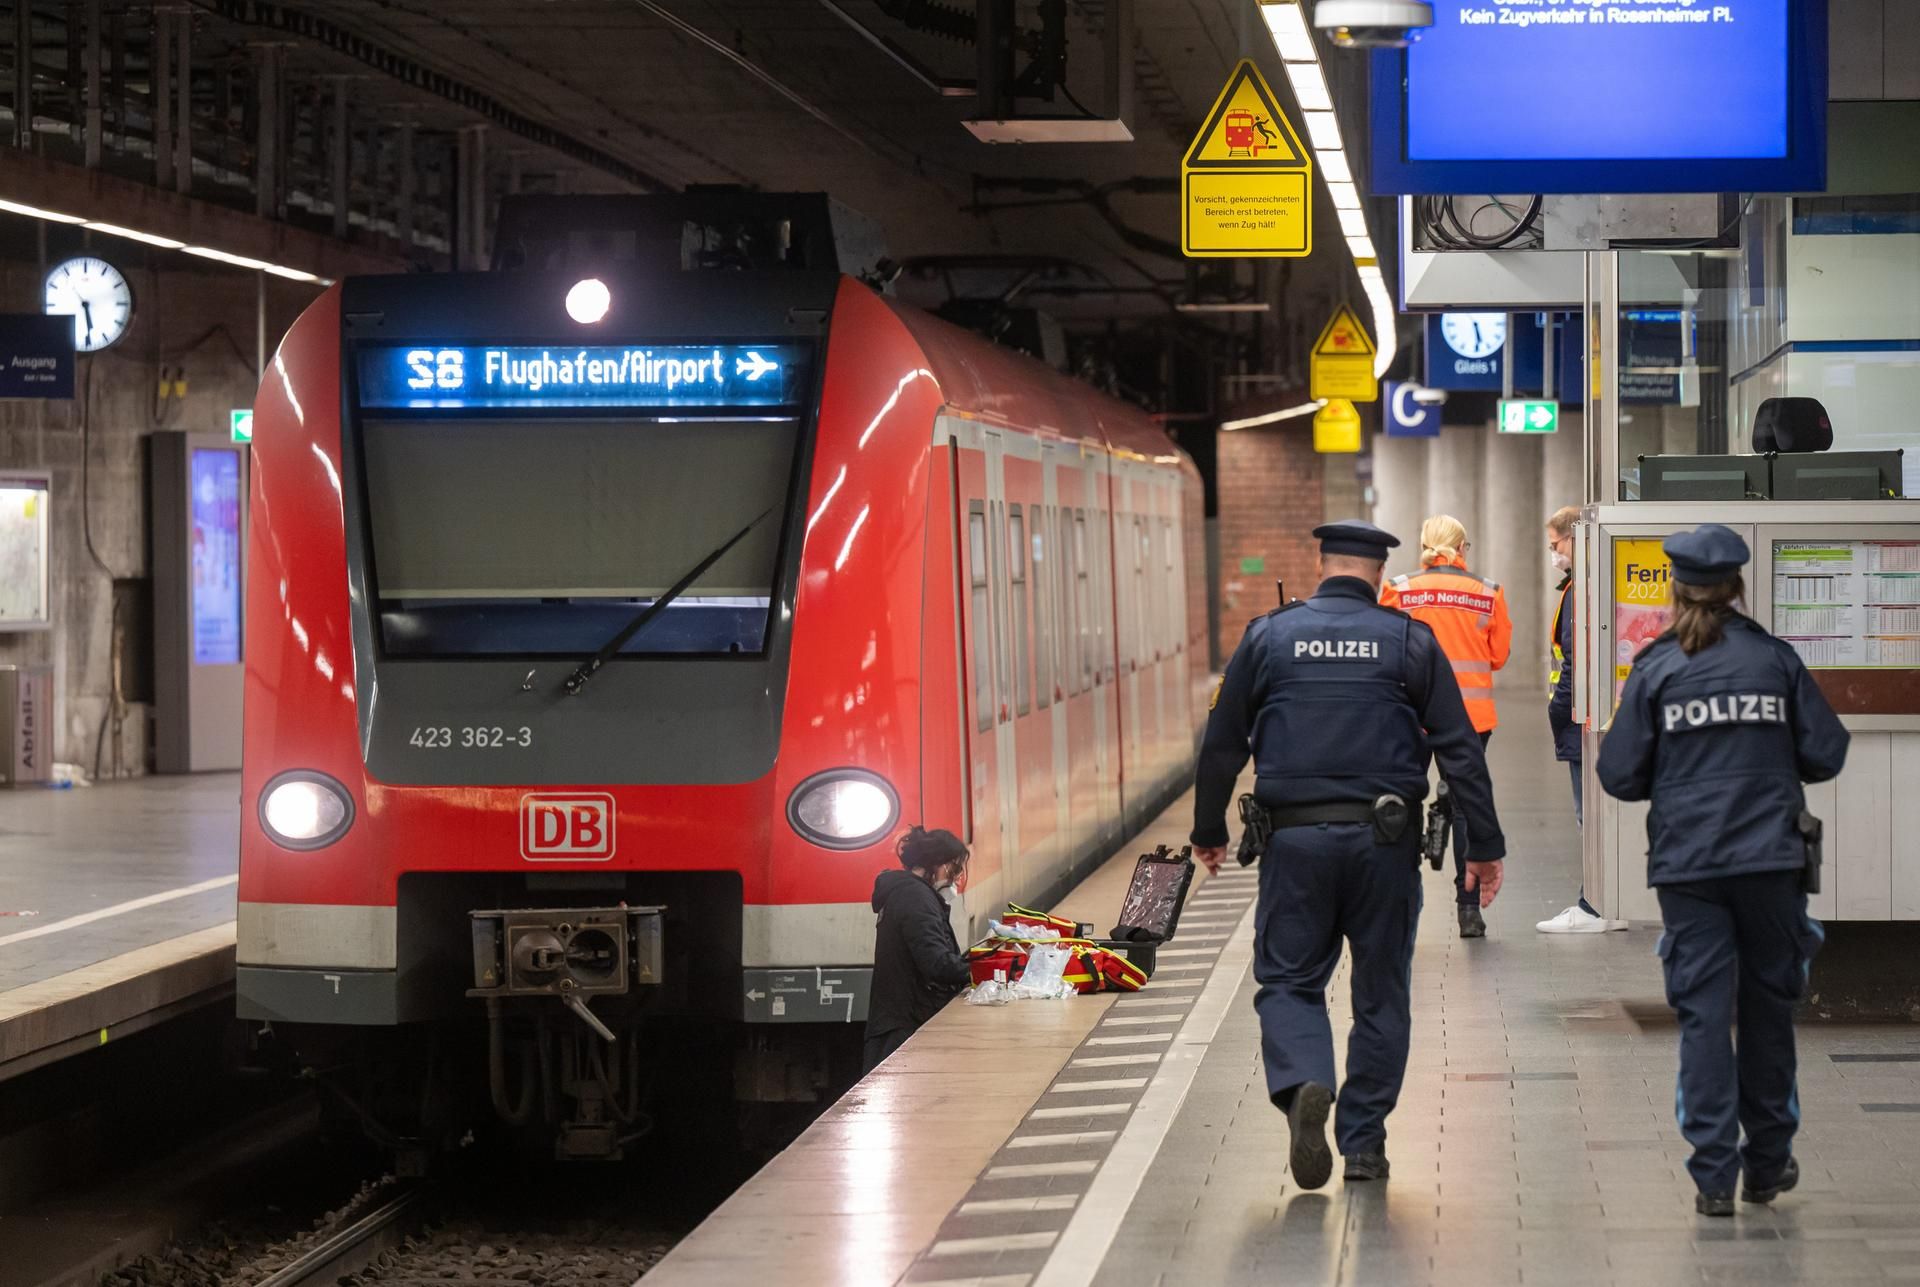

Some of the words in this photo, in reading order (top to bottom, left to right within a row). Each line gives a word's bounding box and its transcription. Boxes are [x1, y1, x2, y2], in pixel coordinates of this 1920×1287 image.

[1460, 8, 1496, 24] Kein
[1499, 8, 1588, 27] Zugverkehr
[1589, 8, 1604, 24] in
[1607, 7, 1711, 24] Rosenheimer
[1713, 6, 1734, 22] Pl.
[1194, 196, 1228, 204] Vorsicht,
[1230, 195, 1300, 204] gekennzeichneten
[1205, 208, 1235, 216] Bereich
[1236, 208, 1252, 216] erst
[1254, 208, 1288, 217] betreten,
[1241, 220, 1257, 229] Zug
[1258, 220, 1276, 229] hält!
[11, 355, 57, 370] Ausgang
[407, 350, 464, 389] S8
[486, 351, 723, 390] Flughafen/Airport
[1454, 359, 1489, 375] Gleis
[1490, 360, 1497, 374] 1
[1392, 381, 1427, 427] C
[1627, 583, 1667, 599] 2021
[1437, 592, 1491, 610] Notdienst
[1294, 640, 1379, 658] POLIZEI
[1663, 695, 1787, 731] POLIZEI
[22, 700, 33, 769] Abfall
[409, 727, 452, 748] 423
[461, 726, 532, 747] 362-3
[534, 805, 603, 849] DB
